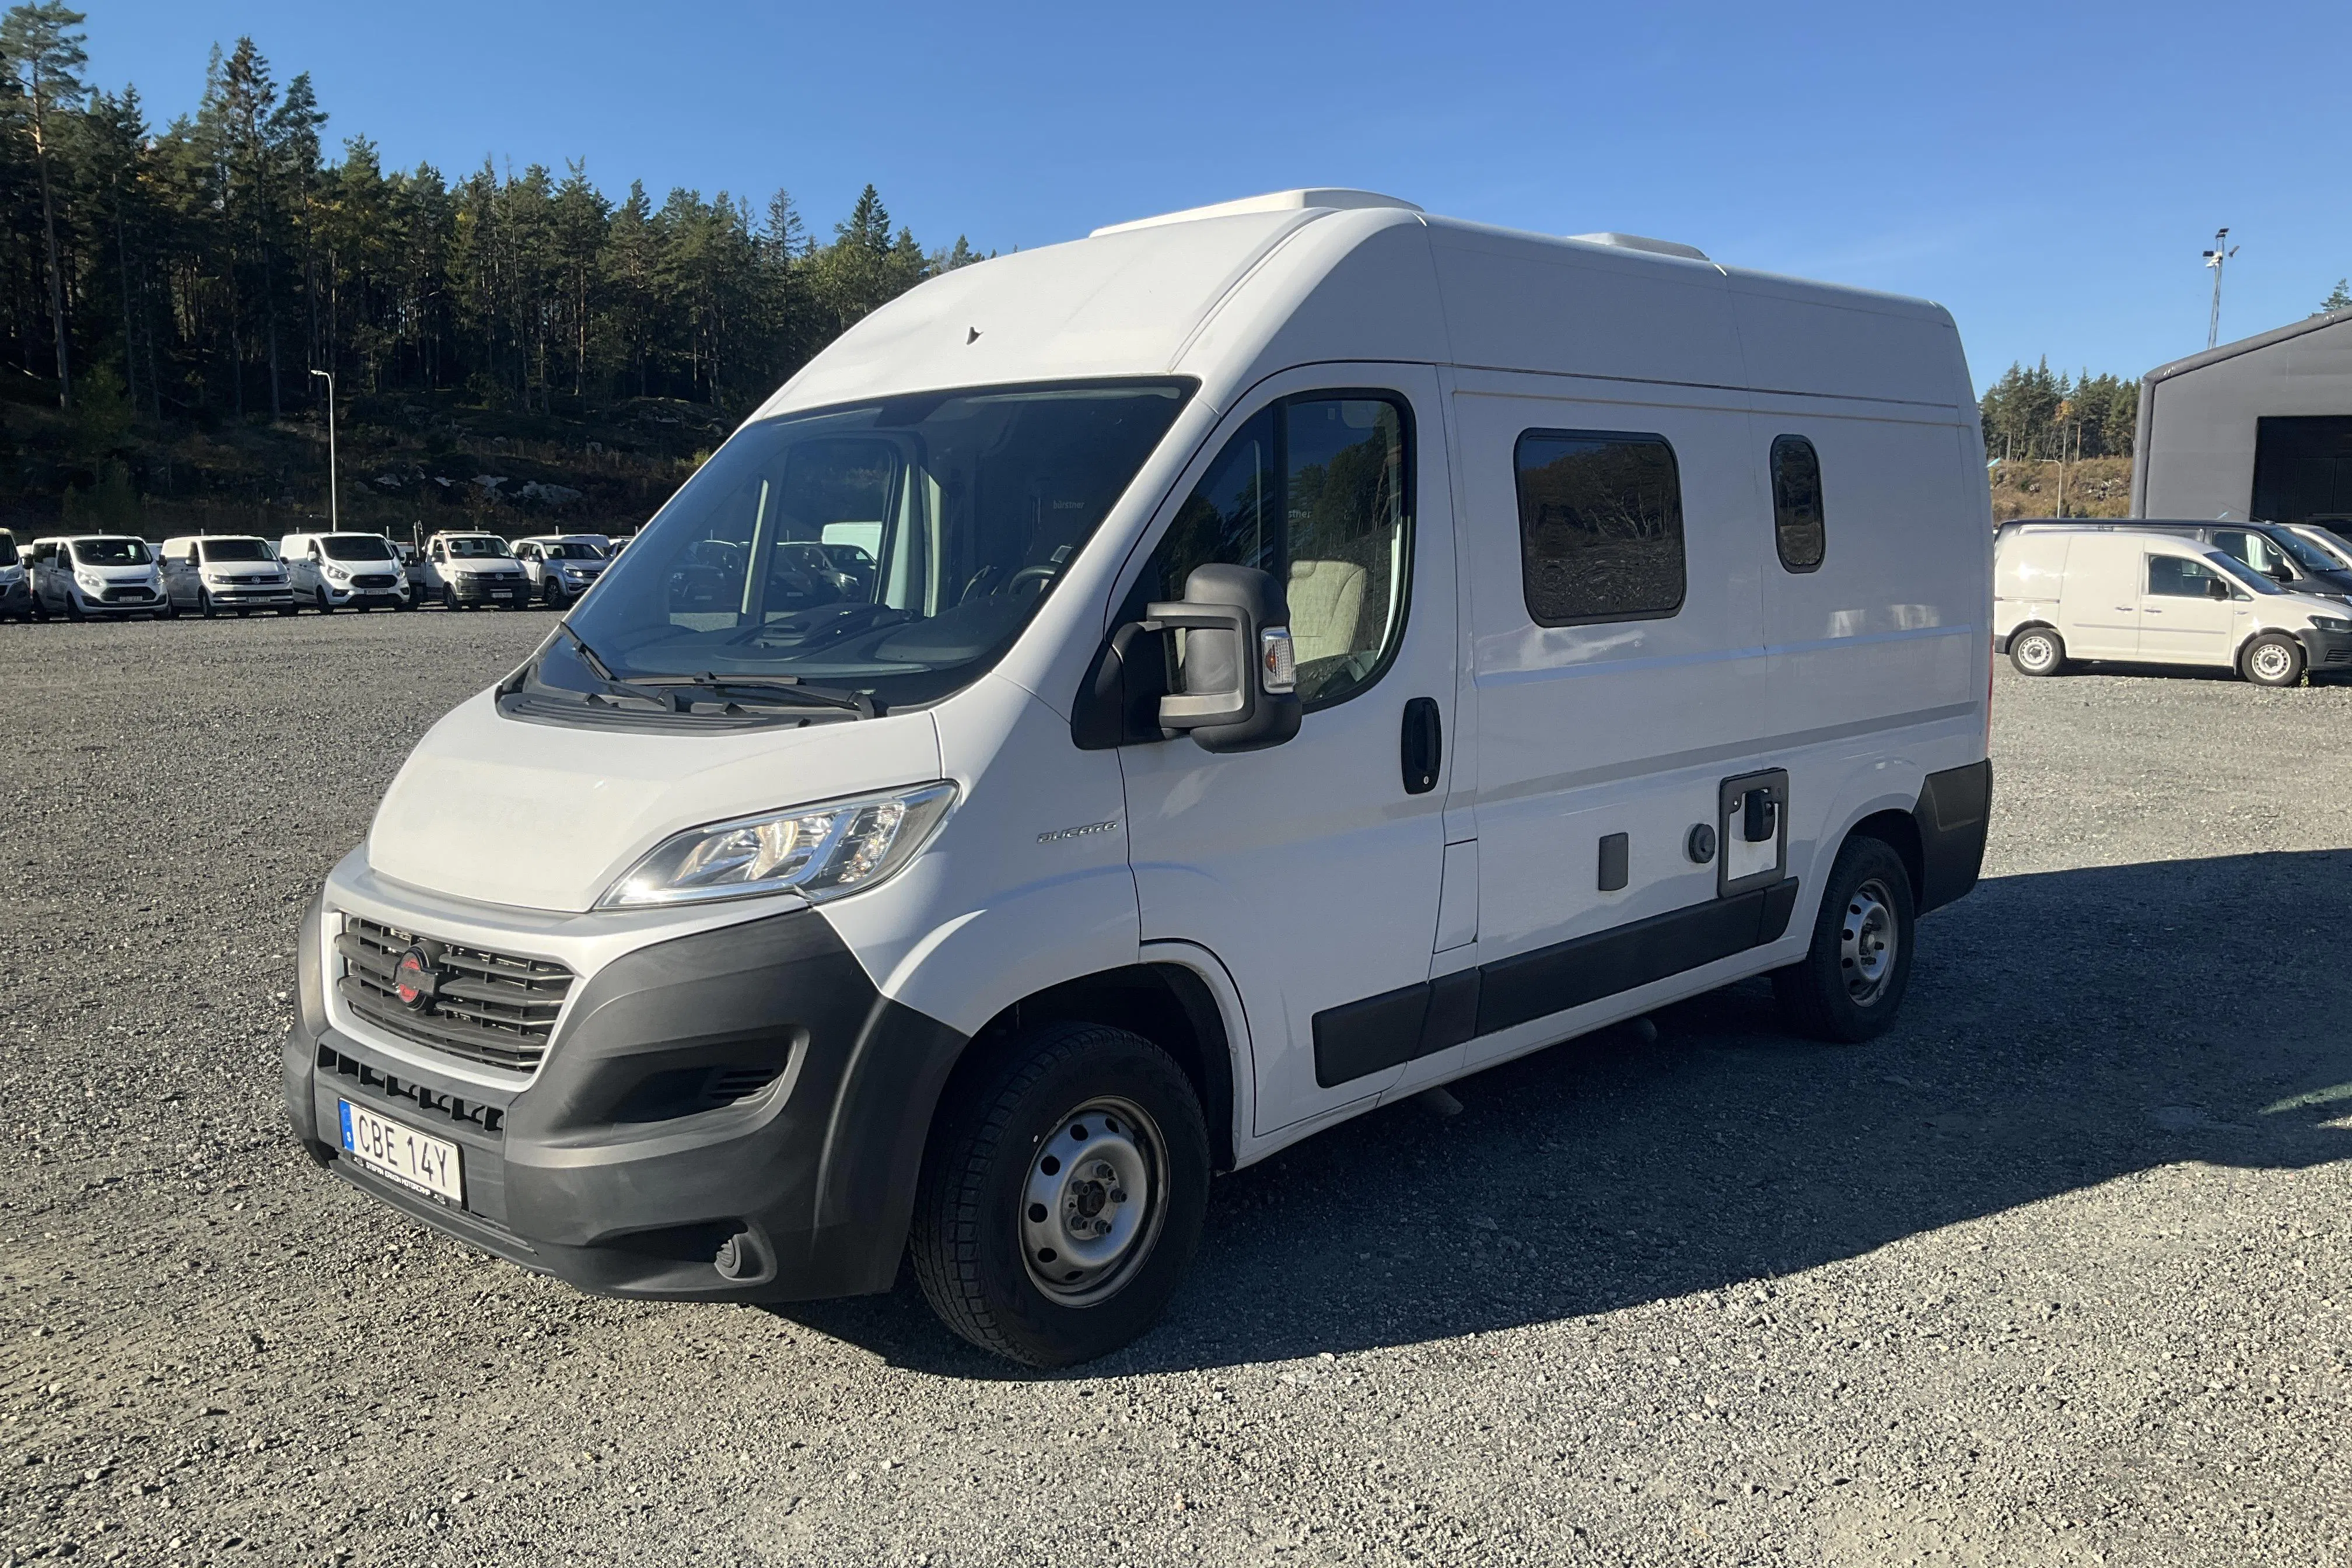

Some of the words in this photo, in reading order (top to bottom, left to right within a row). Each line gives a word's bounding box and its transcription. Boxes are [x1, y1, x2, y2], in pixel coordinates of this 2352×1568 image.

[1288, 509, 1312, 518] stner
[1037, 821, 1117, 844] DUCATO
[346, 1131, 351, 1142] S
[359, 1115, 397, 1166] CBE
[407, 1136, 447, 1188] 14Y
